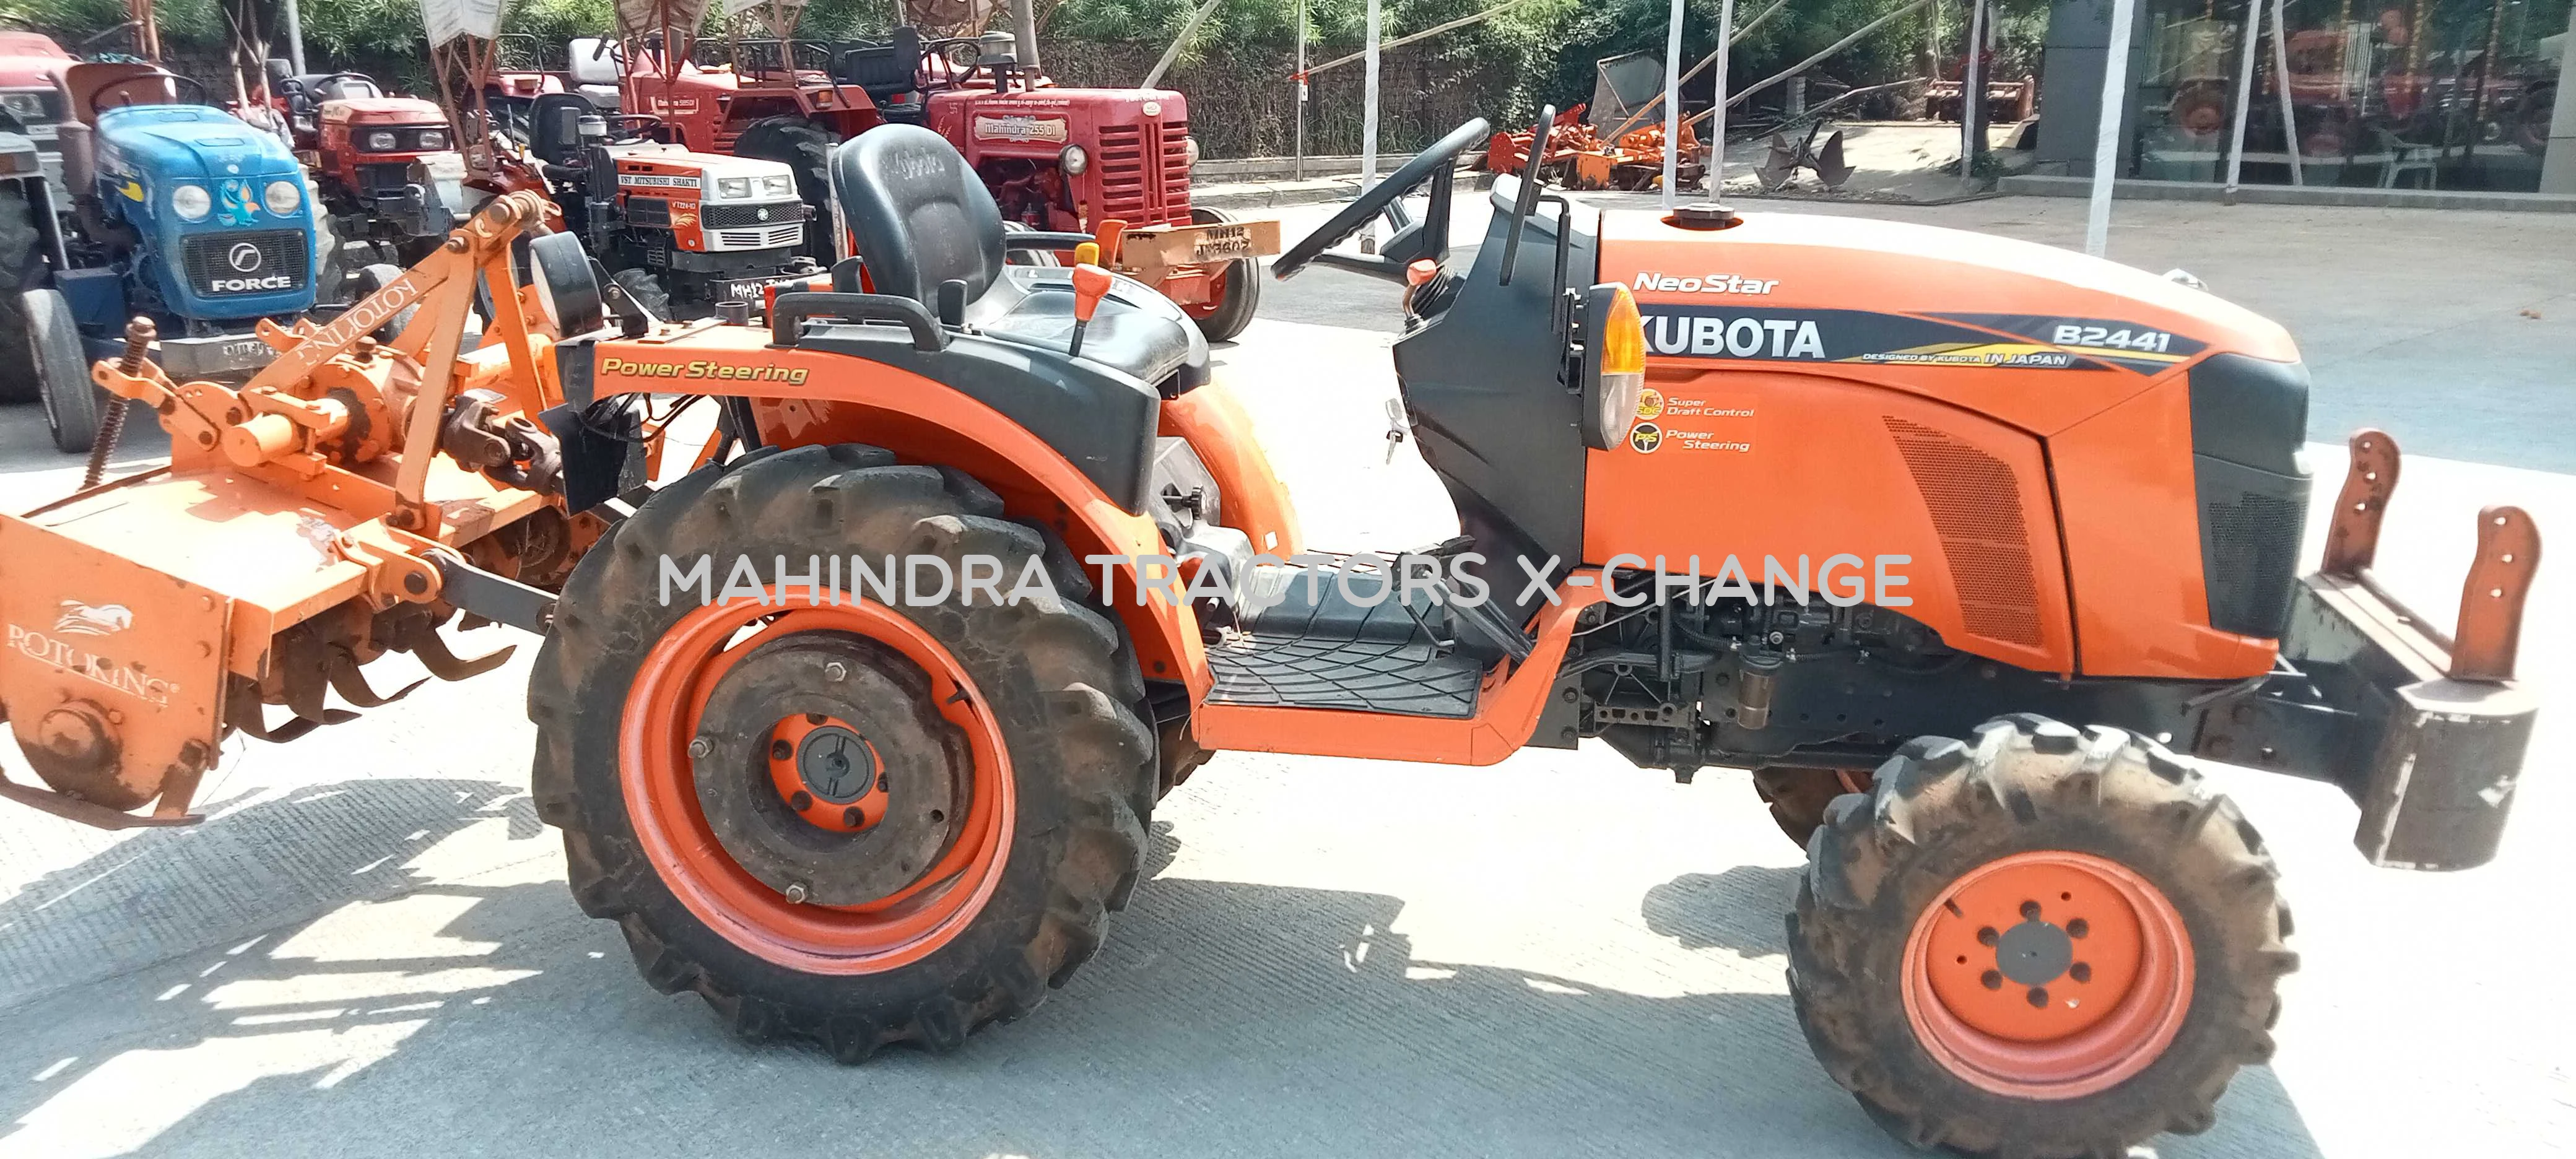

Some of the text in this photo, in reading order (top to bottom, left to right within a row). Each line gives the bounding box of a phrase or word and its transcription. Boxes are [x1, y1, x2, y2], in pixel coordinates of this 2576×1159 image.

[985, 123, 1056, 135] Mahindra 255 DI
[620, 176, 697, 187] VST MITSUBISHI SHAKTI
[212, 276, 292, 292] FORCE
[1632, 272, 1780, 295] NeoStar
[730, 282, 765, 300] MH12
[2053, 325, 2170, 352] B2441
[1862, 353, 1918, 361] DESIGNED
[1983, 354, 2004, 363] IN
[2005, 354, 2067, 365] JAPAN
[601, 358, 808, 386] Power Steering
[1667, 397, 1706, 407] Super
[1667, 407, 1754, 417] Draft Control
[1666, 430, 1714, 440] Power
[1682, 440, 1750, 452] Steering
